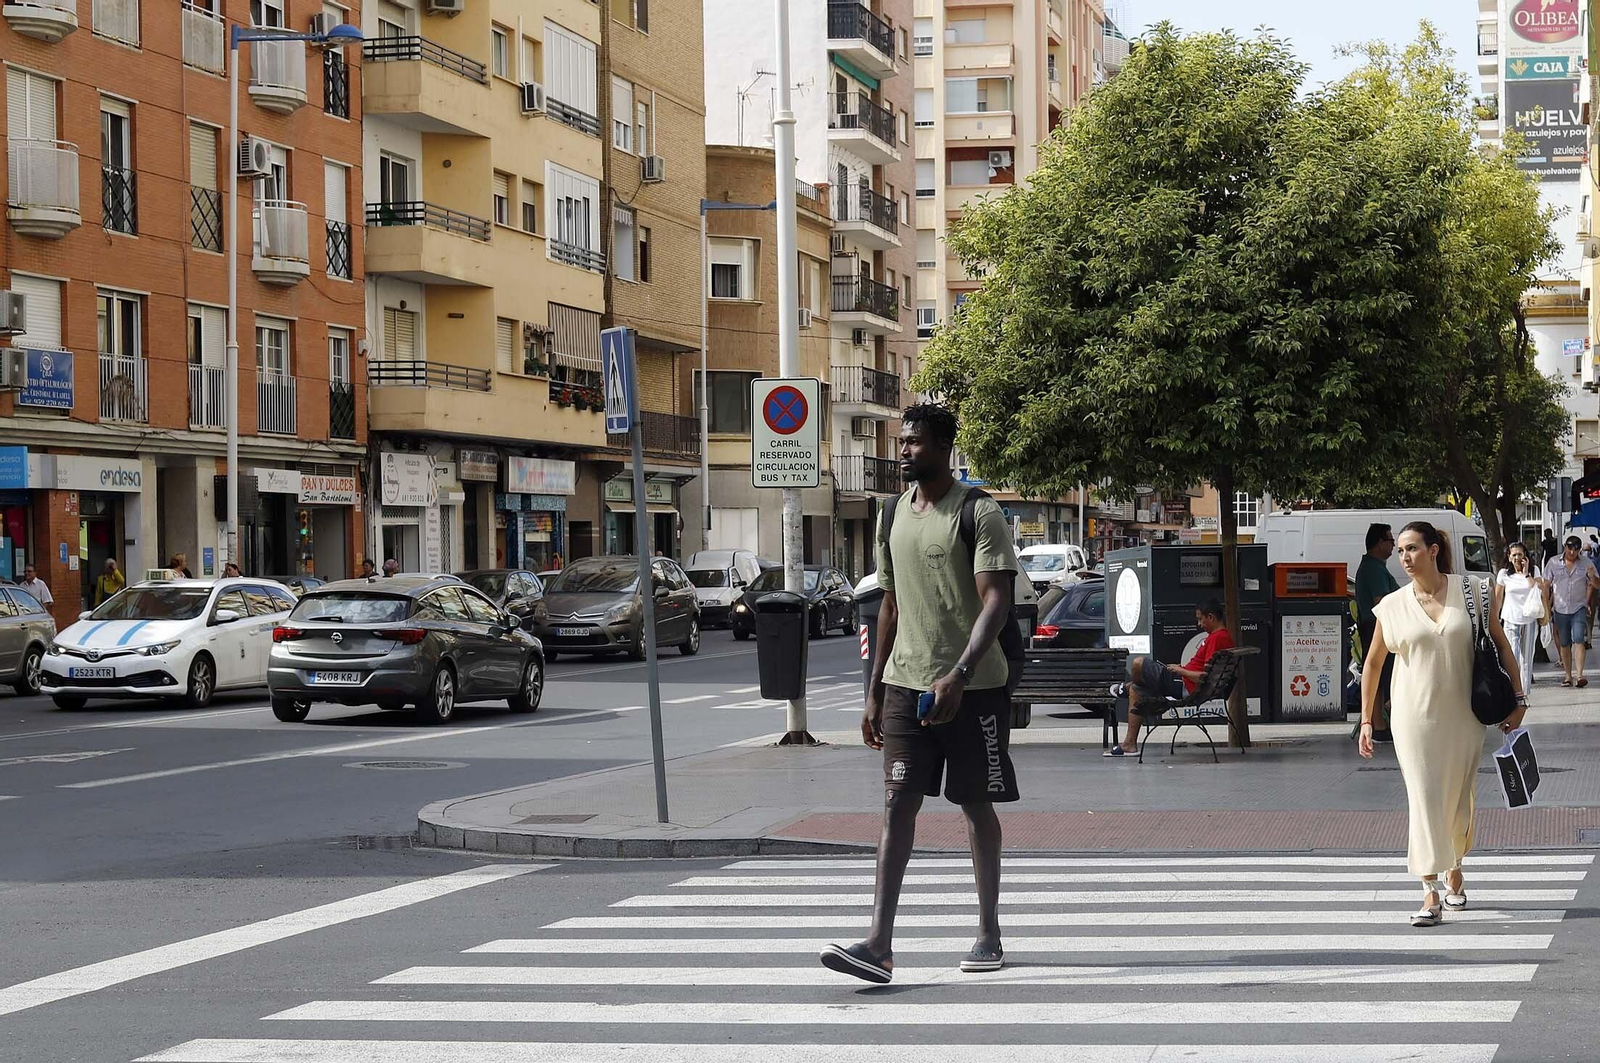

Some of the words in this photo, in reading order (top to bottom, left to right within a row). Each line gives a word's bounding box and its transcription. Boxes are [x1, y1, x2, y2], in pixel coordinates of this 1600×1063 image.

[1533, 62, 1565, 73] CAJA
[1525, 129, 1561, 139] azulejos
[1562, 130, 1568, 138] y
[1553, 145, 1585, 156] azulejos
[770, 440, 802, 448] CARRIL
[760, 451, 812, 459] RESERVADO
[756, 463, 816, 471] CIRCULACION
[100, 465, 141, 486] endesa
[761, 474, 779, 482] BUS
[301, 477, 317, 490] PAN
[318, 478, 325, 490] Y
[326, 477, 354, 491] DULCES
[302, 491, 318, 502] San
[1180, 570, 1194, 578] OLSAS
[1462, 576, 1476, 619] BAYLOLA
[1296, 638, 1320, 646] Aceite
[75, 669, 94, 677] 2523
[96, 669, 112, 677] KTR
[316, 673, 339, 681] 5408
[341, 673, 359, 682] KRJ
[979, 714, 1006, 792] SPALDING
